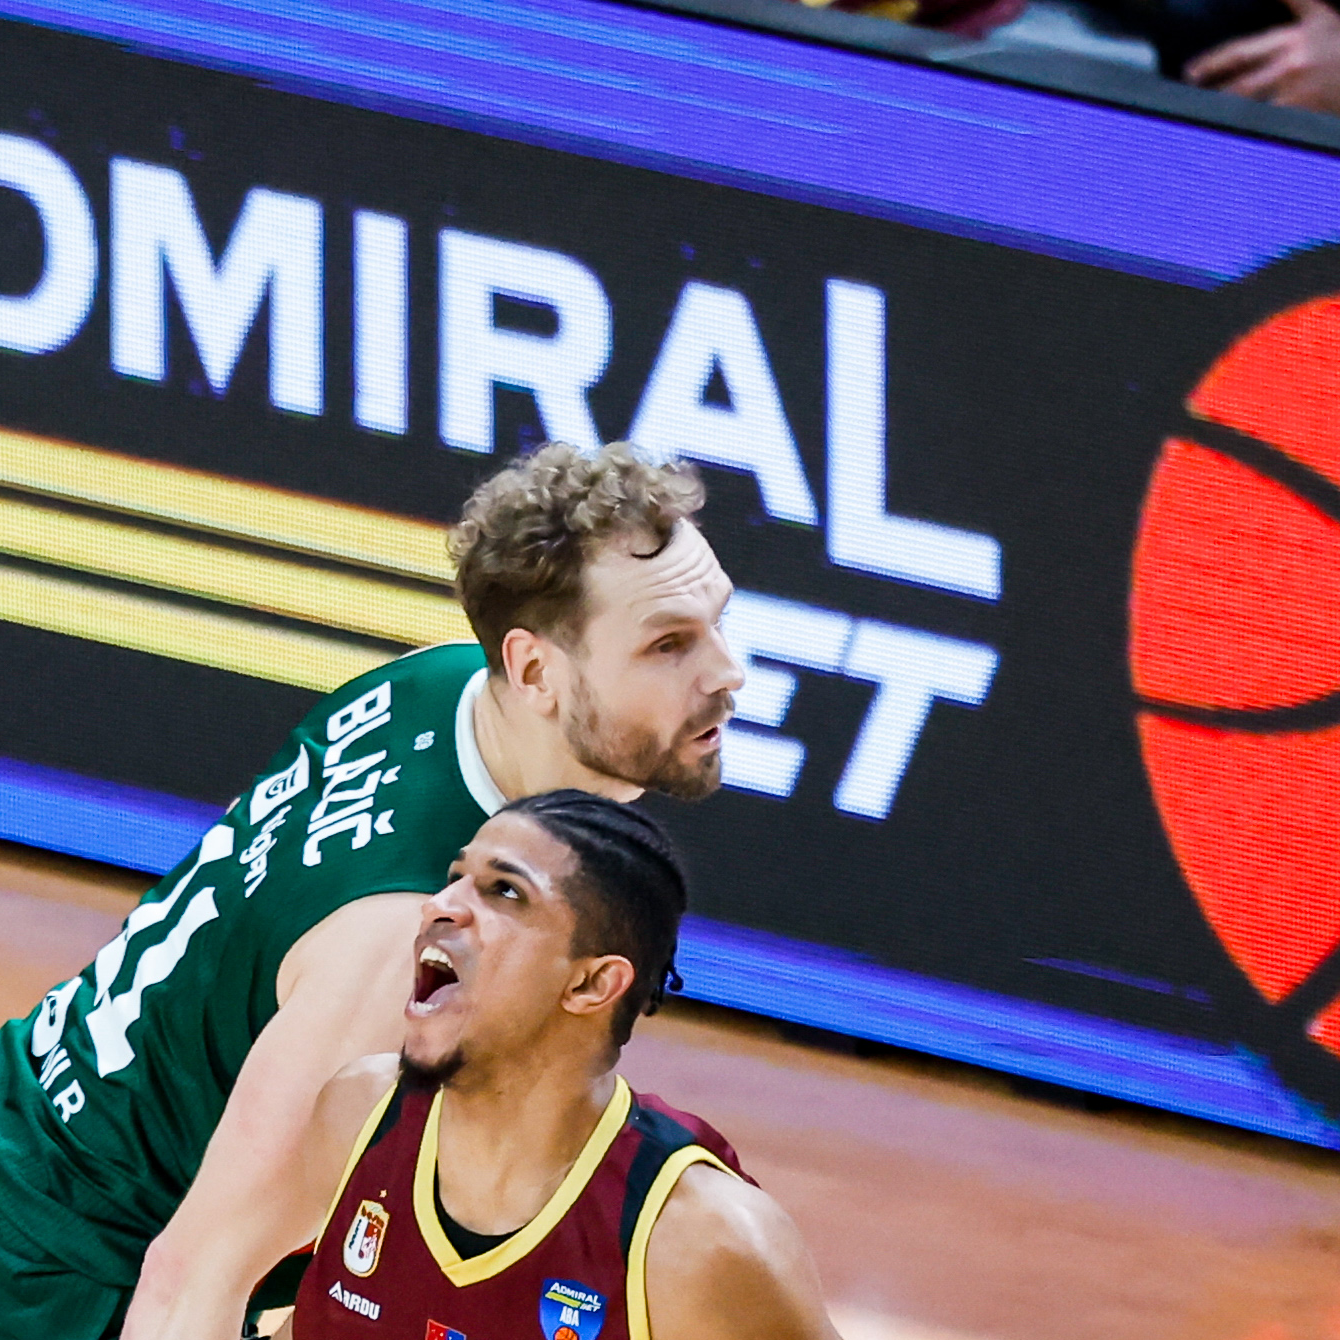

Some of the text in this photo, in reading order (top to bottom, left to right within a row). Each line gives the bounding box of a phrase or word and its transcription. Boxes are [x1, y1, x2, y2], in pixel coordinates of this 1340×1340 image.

[721, 588, 1001, 820] ET
[550, 1282, 601, 1306] ADMIRAL
[559, 1306, 580, 1327] ABA
